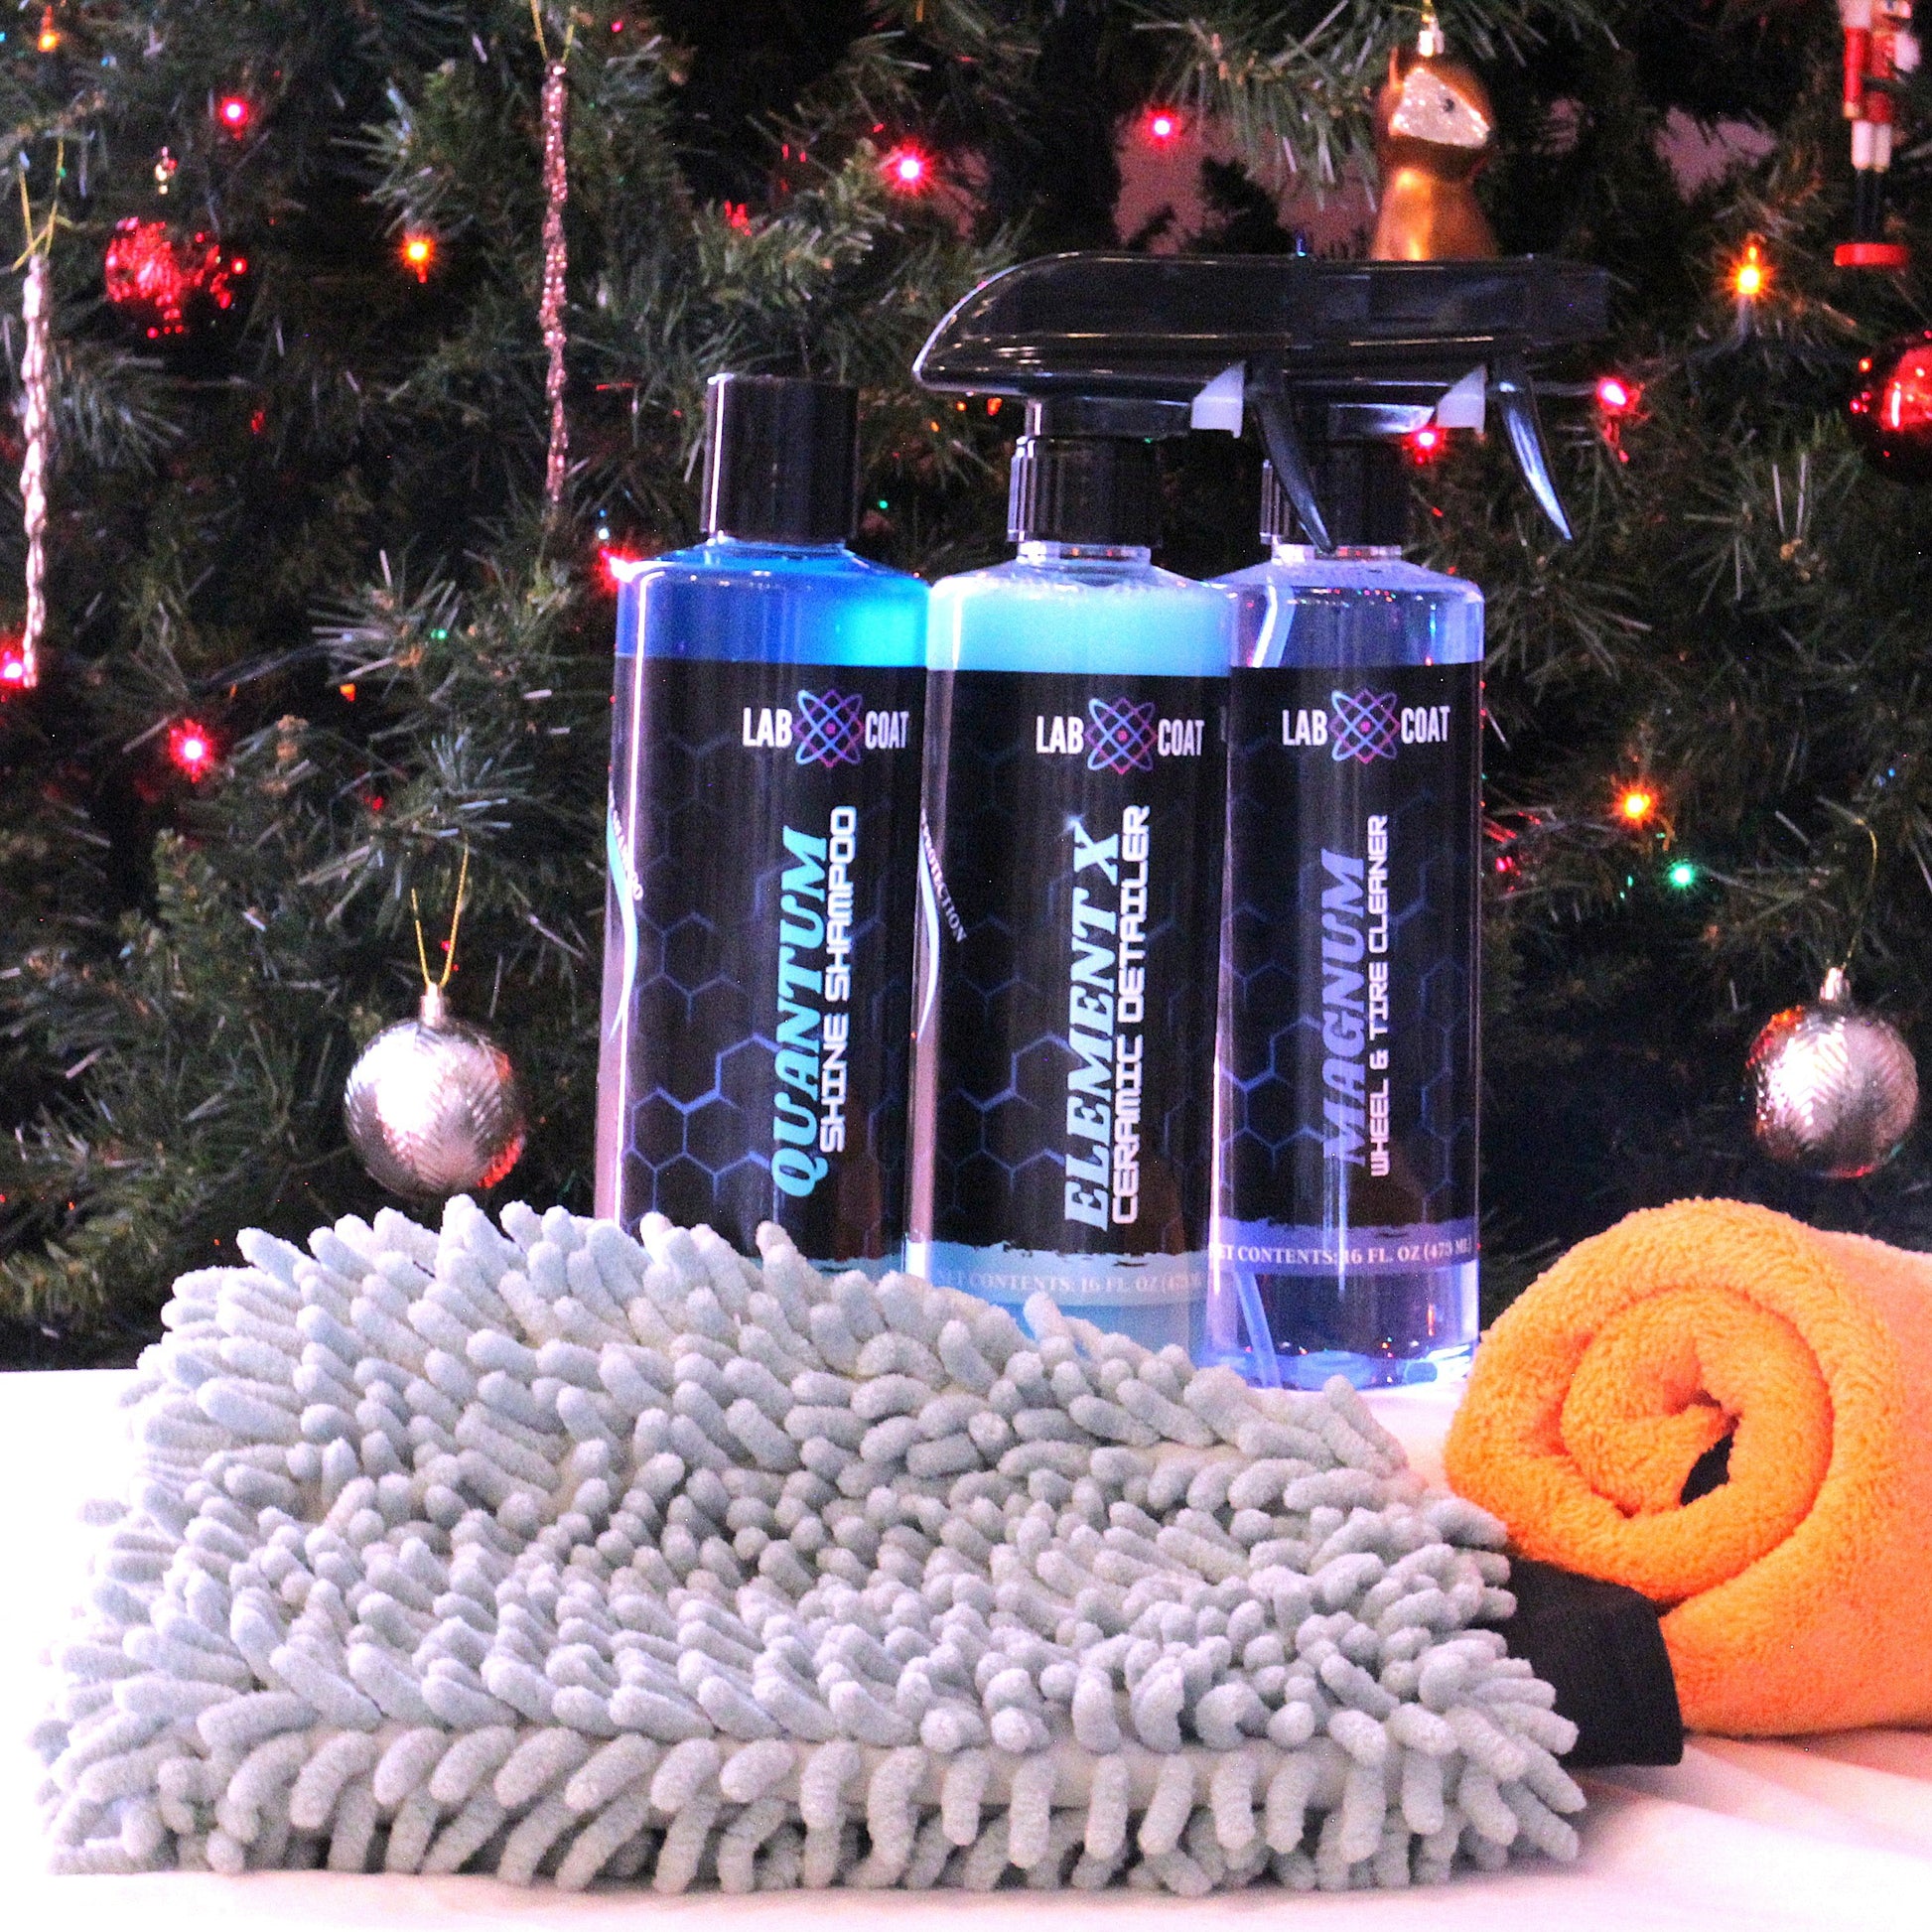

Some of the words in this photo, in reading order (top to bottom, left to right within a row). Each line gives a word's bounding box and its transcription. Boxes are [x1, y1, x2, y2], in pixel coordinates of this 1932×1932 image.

[742, 707, 793, 748] LAB
[864, 710, 909, 750] COAT
[1035, 715, 1084, 755] LAB
[1157, 719, 1205, 757] COAT
[1282, 709, 1328, 747] LAB
[1400, 706, 1450, 745] COAT
[823, 805, 857, 1003] SHAMPOO
[1073, 820, 1120, 887] X
[1366, 814, 1389, 954] CLEANER
[1116, 804, 1151, 1025] DETAILER
[771, 825, 828, 1197] QUANTUM
[1063, 888, 1118, 1232] ELEMENT
[1321, 848, 1366, 1168] MAGNUM
[1368, 961, 1389, 1042] TIRE
[1369, 1048, 1389, 1071] &
[819, 1012, 850, 1154] SHINE
[1112, 1034, 1144, 1225] CERAMIC
[1369, 1077, 1390, 1177] WHEEL
[1397, 1244, 1421, 1262] OZ
